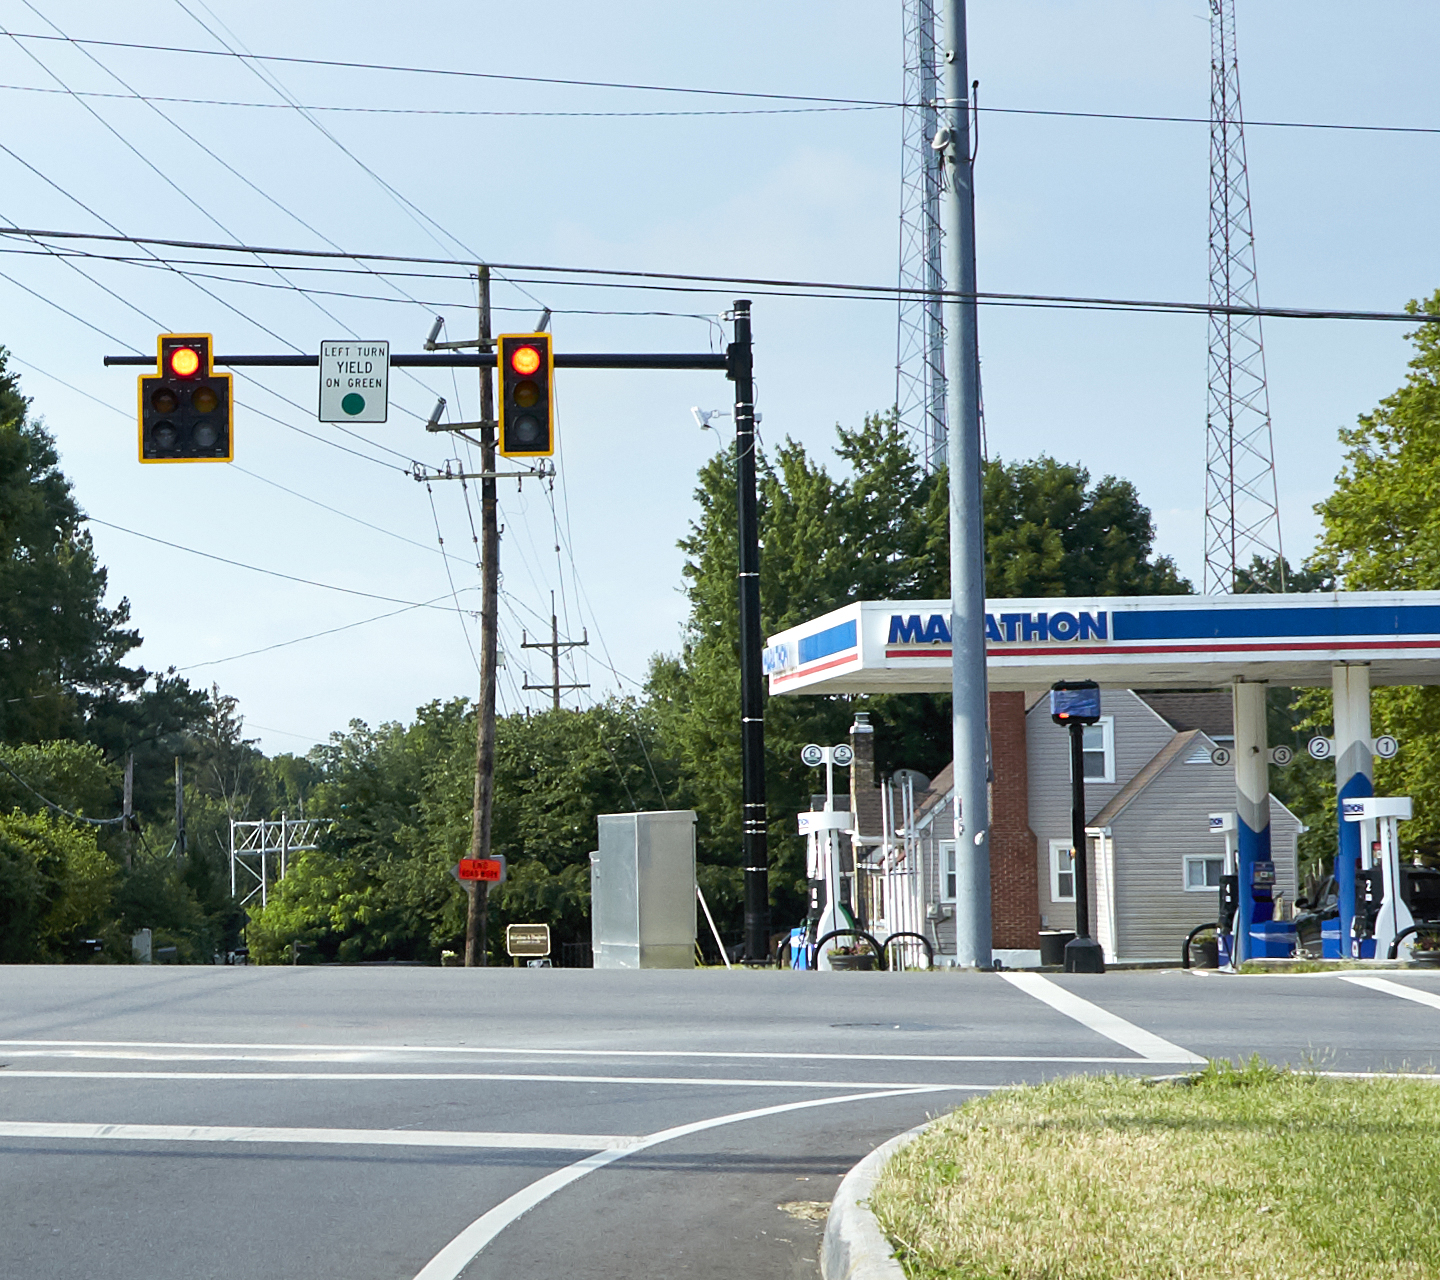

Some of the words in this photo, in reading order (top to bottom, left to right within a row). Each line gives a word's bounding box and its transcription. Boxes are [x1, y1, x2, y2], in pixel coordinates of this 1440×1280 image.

[324, 347, 350, 357] LEFT
[357, 347, 385, 357] TURN
[336, 361, 373, 374] YIELD
[326, 378, 340, 388] ON
[347, 378, 382, 388] GREEN
[888, 611, 1108, 645] MAATHON
[809, 748, 816, 758] 6
[839, 748, 847, 757] 5
[1316, 742, 1325, 753] 2
[1382, 741, 1389, 752] 1
[1216, 750, 1225, 762] 4
[1278, 750, 1287, 761] 3
